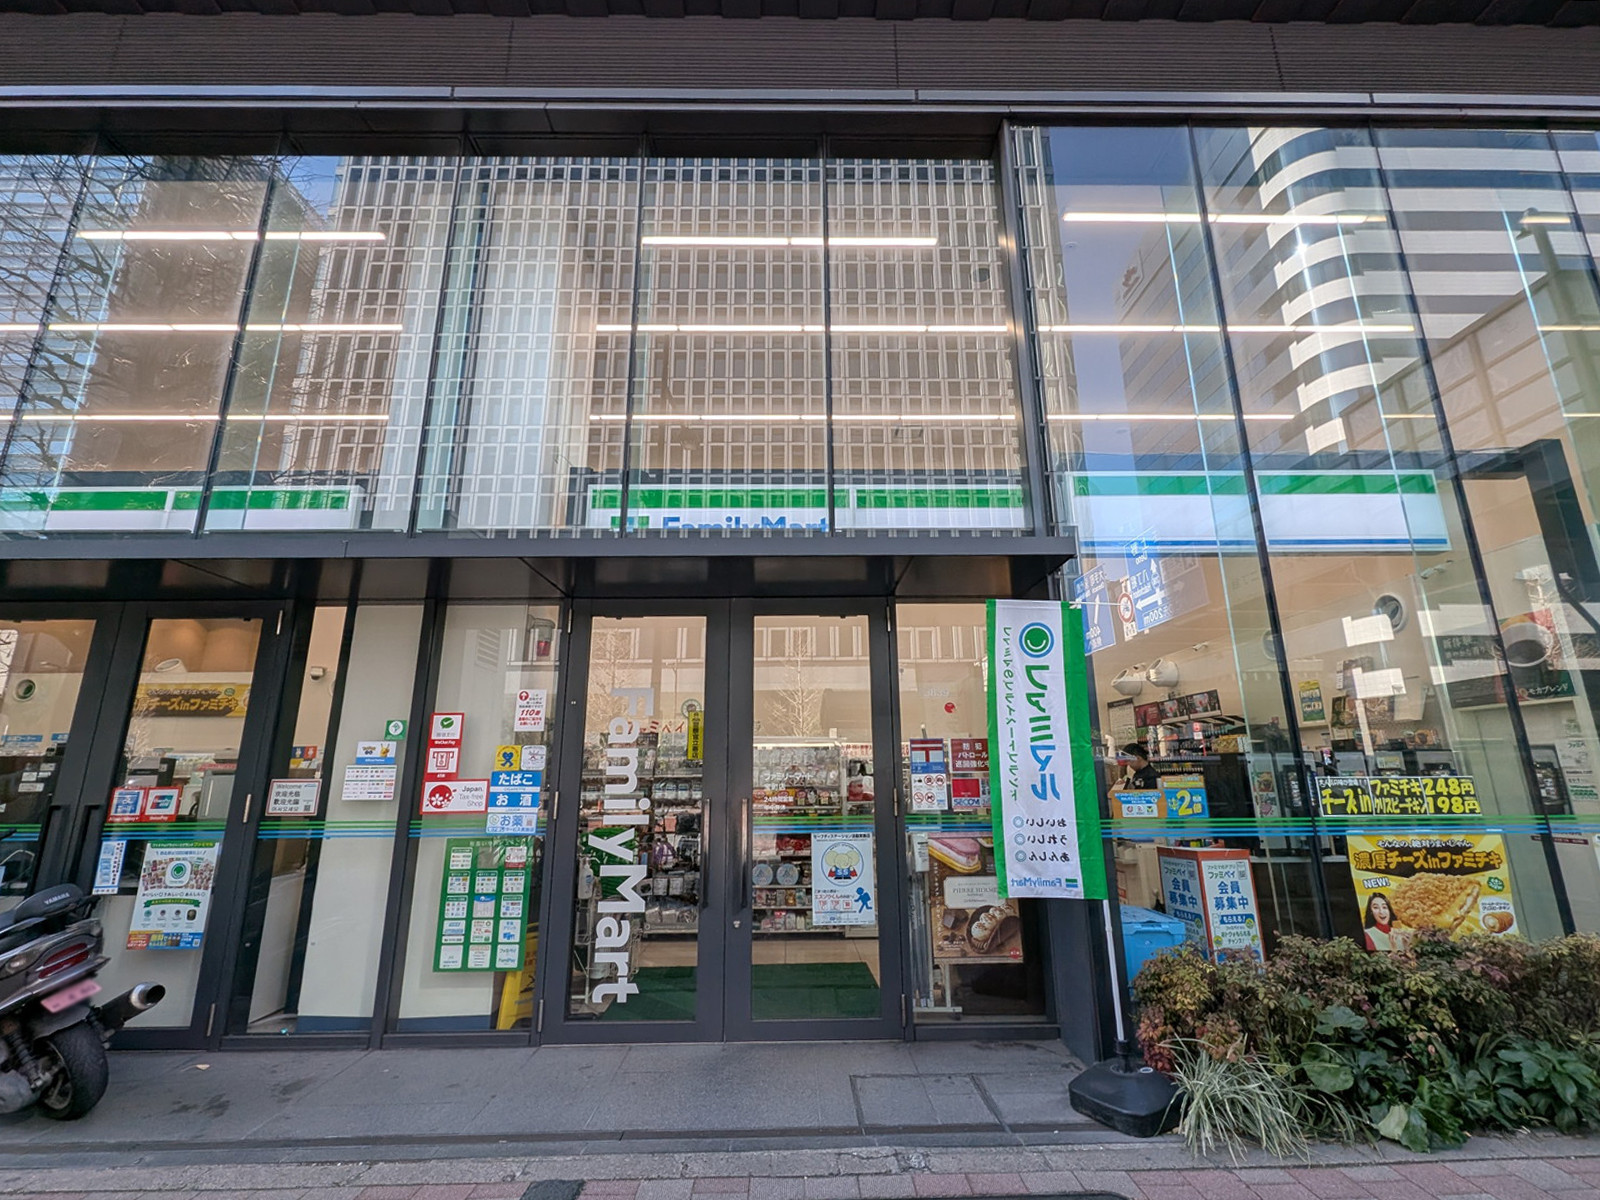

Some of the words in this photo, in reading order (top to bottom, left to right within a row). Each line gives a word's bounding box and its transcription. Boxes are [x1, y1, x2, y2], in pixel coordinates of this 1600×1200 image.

[498, 772, 533, 785] たばこ
[1370, 779, 1423, 795] ファミチキ
[1424, 778, 1475, 795] 248円
[496, 794, 533, 806] お酒
[1374, 797, 1428, 814] クリスピーチキン
[1428, 797, 1481, 814] 198円
[500, 815, 524, 827] お薬
[588, 687, 655, 1005] FamilyMart
[1353, 851, 1503, 870] 濃厚チーズinファミチキ
[1208, 870, 1236, 879] ファミペイ
[1171, 877, 1191, 893] 会員
[1217, 880, 1241, 895] 会員
[1363, 877, 1391, 889] NEW!
[44, 892, 70, 904] YAMAHA
[1169, 891, 1198, 908] 募集中
[1213, 895, 1249, 911] 募集中
